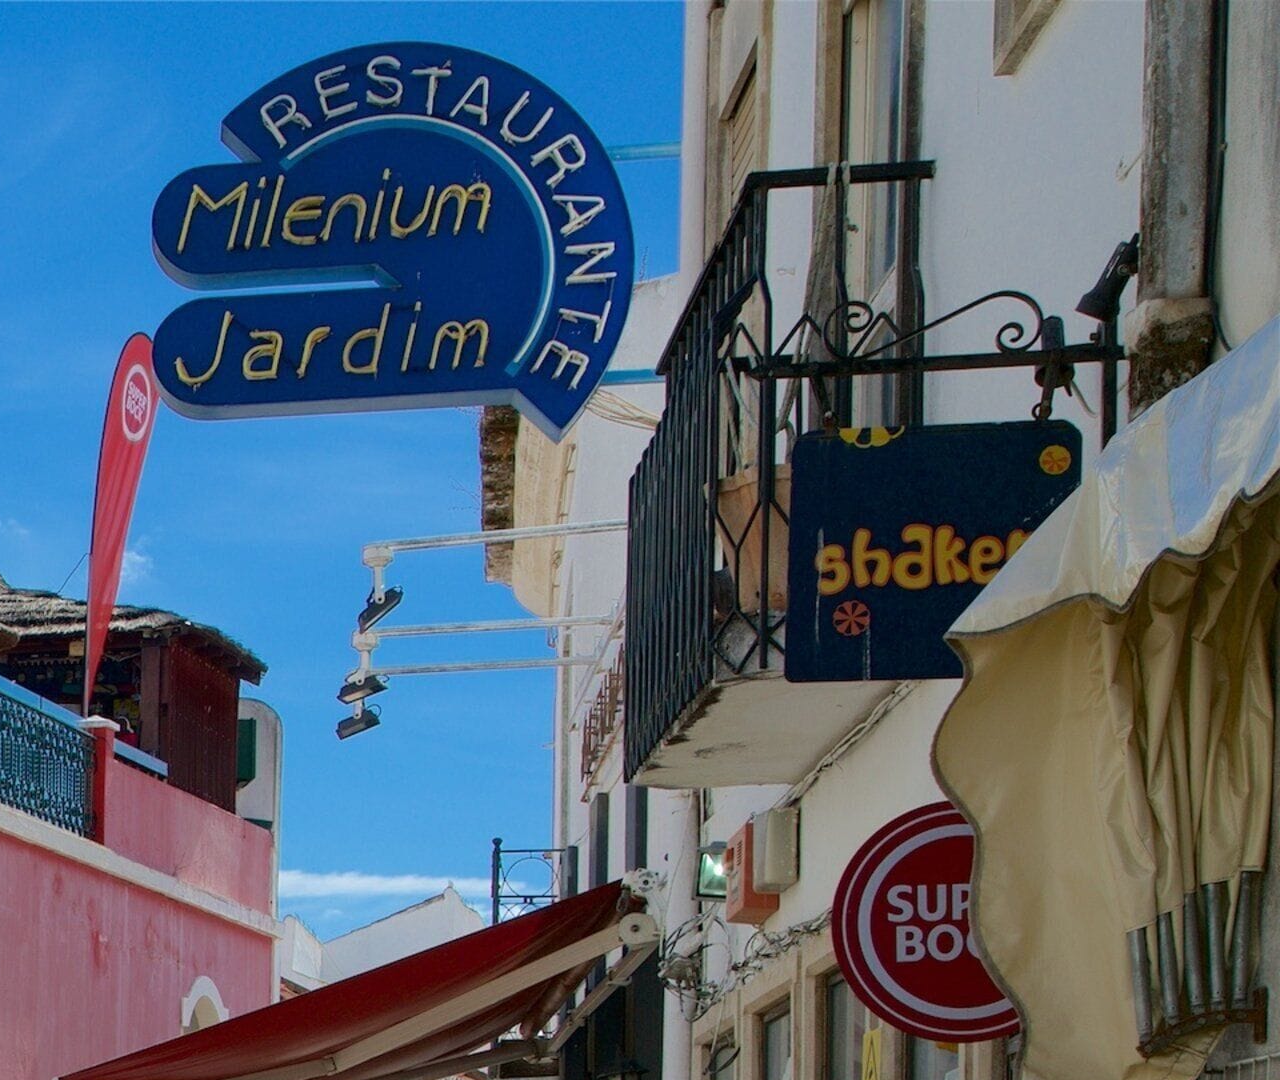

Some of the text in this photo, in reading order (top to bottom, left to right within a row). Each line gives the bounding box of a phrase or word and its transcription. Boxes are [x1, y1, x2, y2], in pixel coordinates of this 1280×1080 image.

[177, 167, 491, 254] Milenium
[260, 54, 618, 391] RESTAURANTE
[175, 301, 489, 389] Jardim
[887, 883, 971, 923] SUP
